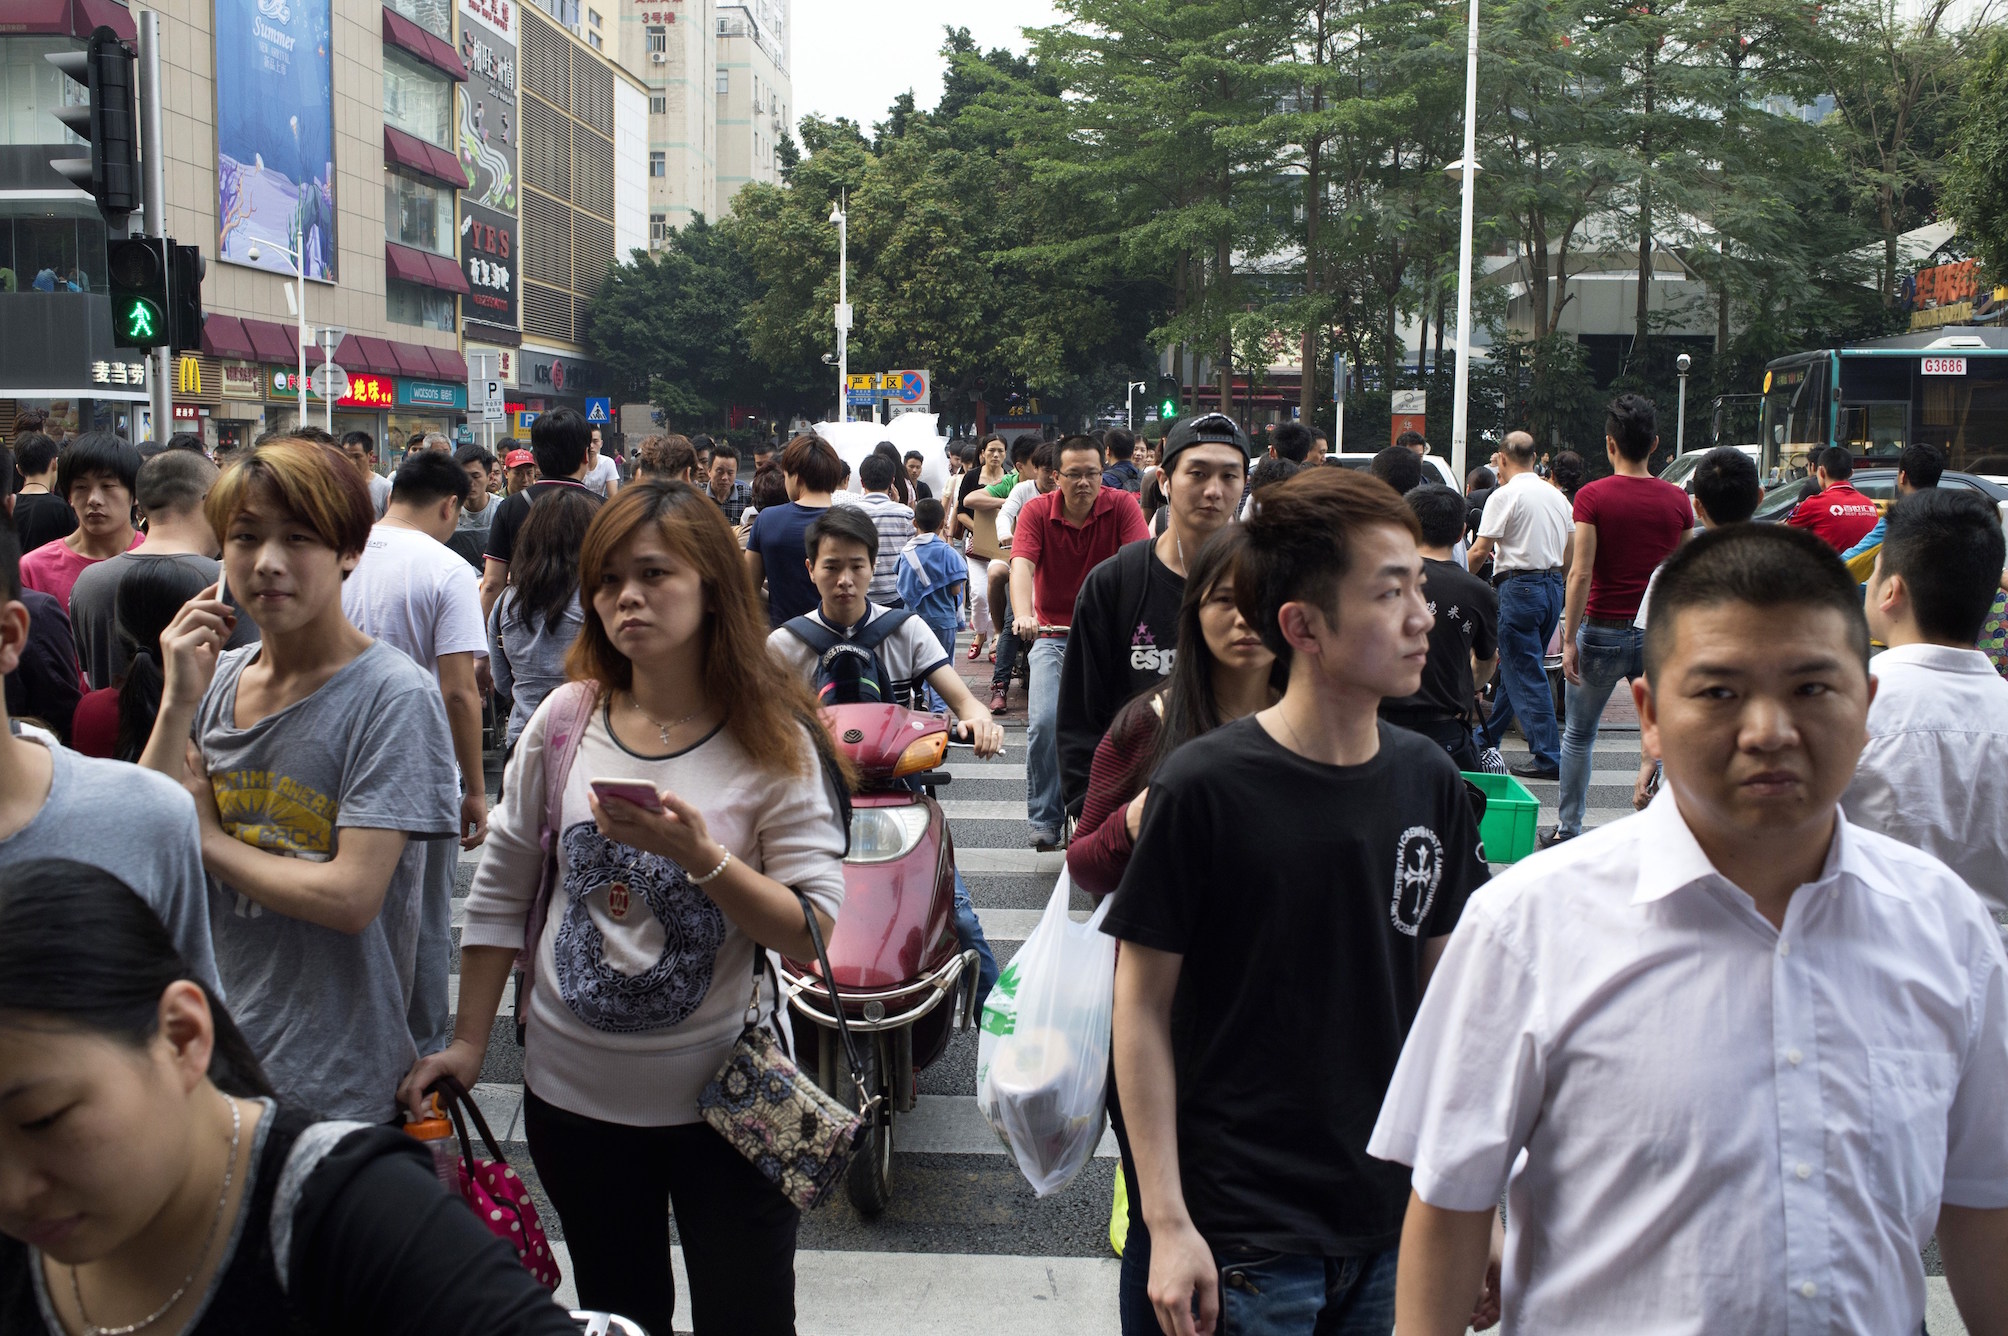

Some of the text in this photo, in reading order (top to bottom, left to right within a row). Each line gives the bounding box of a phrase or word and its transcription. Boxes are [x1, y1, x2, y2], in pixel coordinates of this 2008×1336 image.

[253, 16, 295, 51] Summer
[263, 54, 287, 76] 新品上市
[471, 219, 510, 259] YES
[91, 361, 145, 385] 麦当劳
[1924, 359, 1963, 373] G3686
[413, 387, 439, 400] watsons
[489, 383, 497, 399] P
[176, 408, 194, 417] 麦当劳
[525, 414, 535, 428] P
[227, 770, 276, 789] TIME
